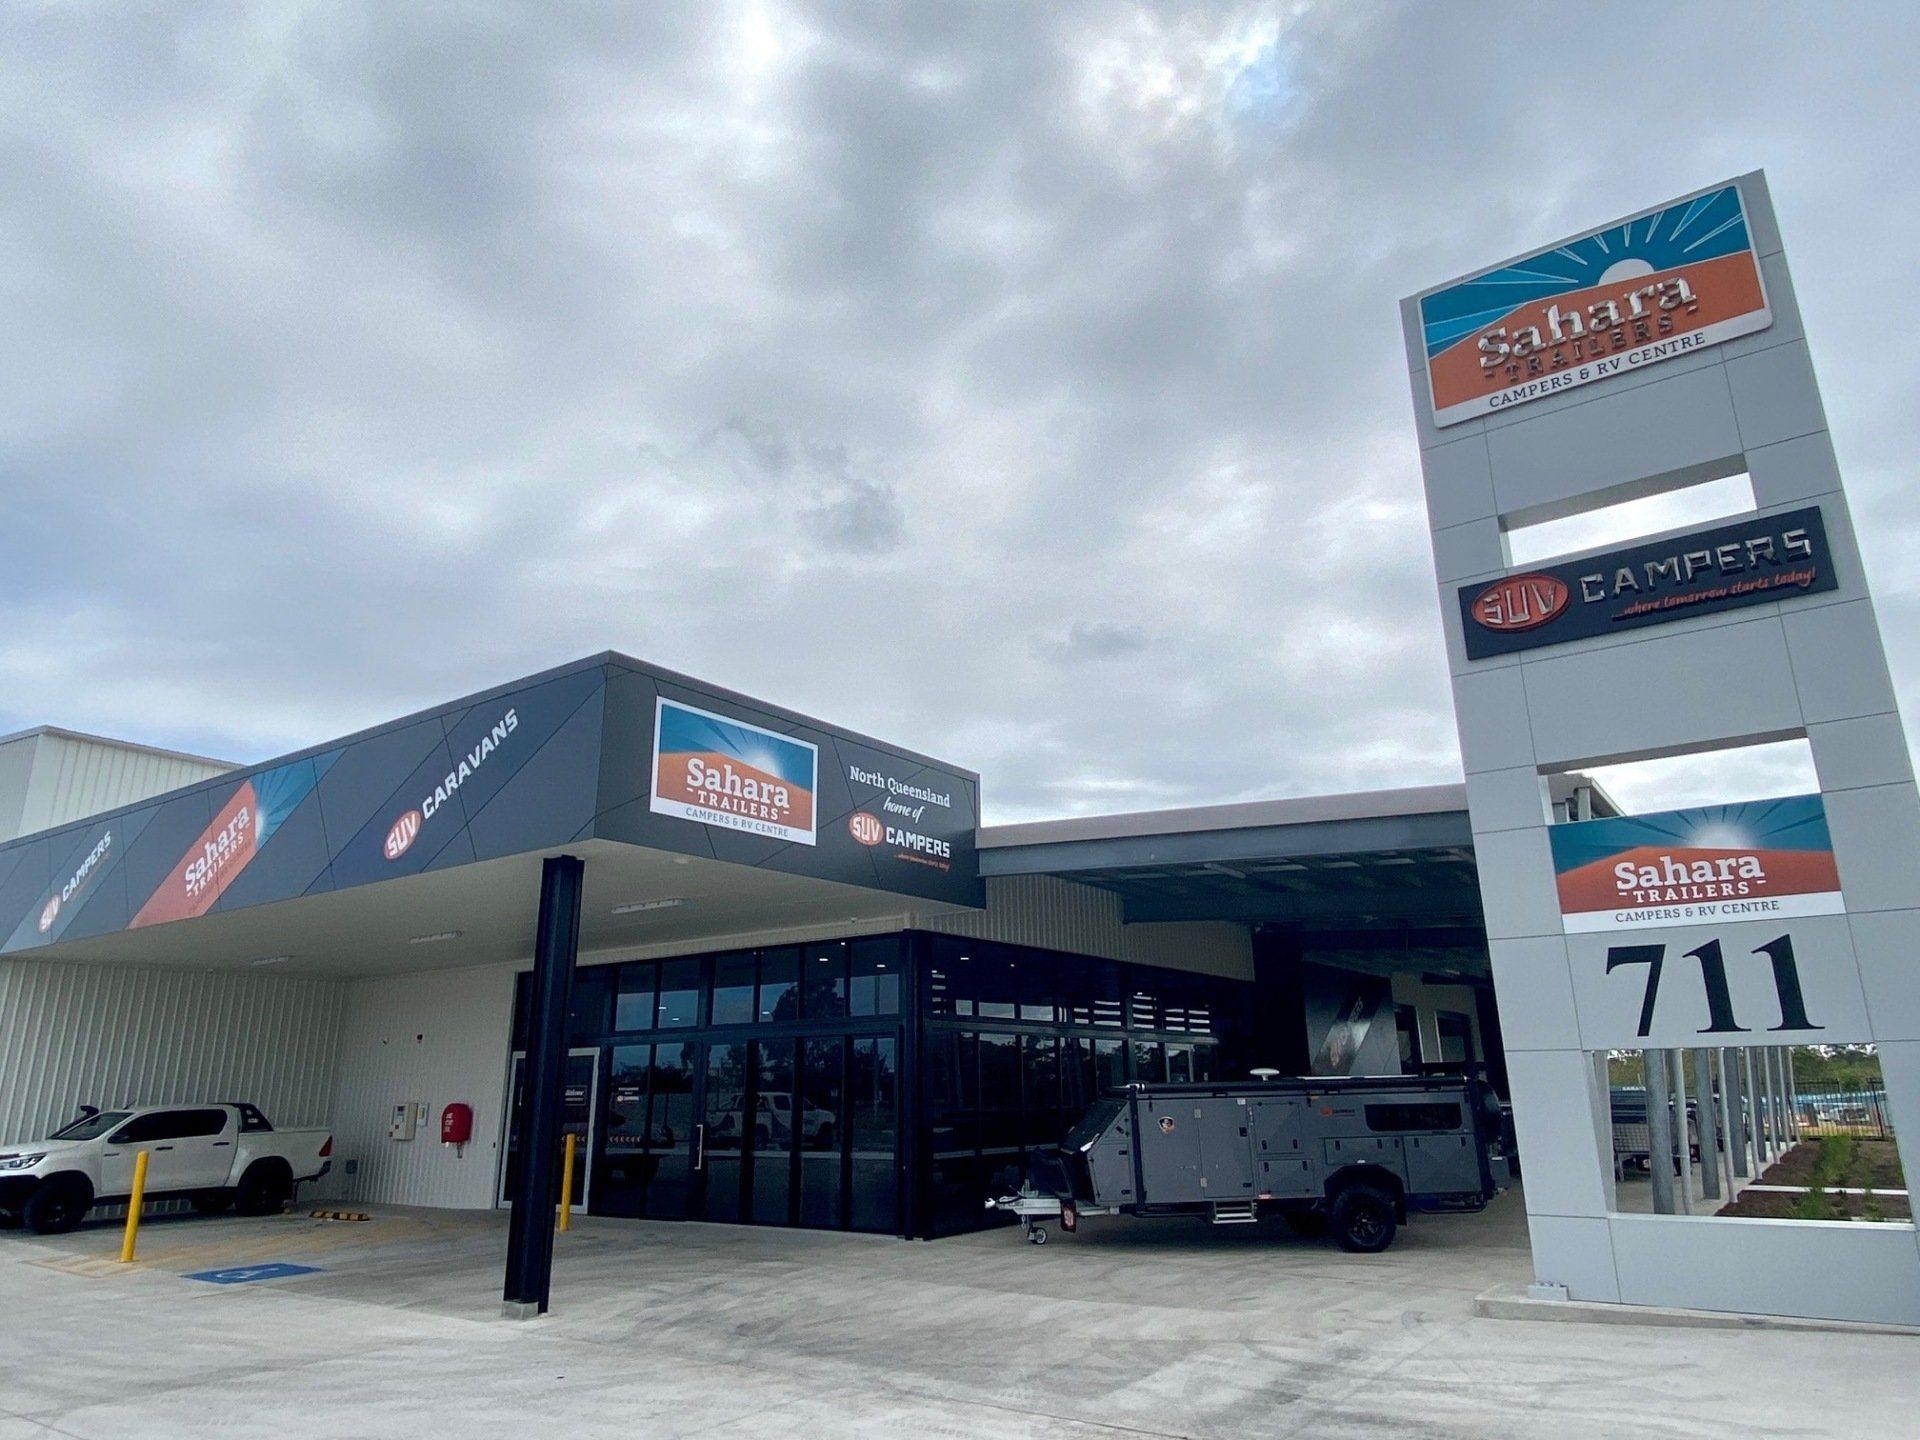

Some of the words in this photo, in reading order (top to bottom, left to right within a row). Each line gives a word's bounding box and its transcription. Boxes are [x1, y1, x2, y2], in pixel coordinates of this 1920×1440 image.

[1477, 277, 1699, 369] Sahara
[1504, 313, 1674, 382] TRAILERS
[1489, 371, 1573, 408] CAMPERS
[1579, 368, 1590, 381] &
[1597, 358, 1621, 376] RV
[1629, 331, 1706, 367] CENTRE
[1484, 582, 1557, 625] SUV
[1579, 528, 1813, 604] CAMPERS
[1663, 588, 1728, 607] tomorrow
[1730, 576, 1770, 595] starts
[1774, 567, 1817, 588] today!
[385, 813, 417, 857] SUV
[422, 708, 519, 820] CARAVANS
[686, 758, 790, 808] Sahara
[698, 789, 779, 821] TRAILERS
[849, 766, 886, 789] North
[887, 777, 951, 808] Queensland
[686, 807, 730, 825] CAMPERS
[732, 818, 738, 826] &
[741, 819, 753, 829] RV
[755, 822, 789, 837] CENTRE
[883, 796, 911, 817] home
[912, 805, 926, 824] of
[185, 806, 250, 892] Sahara
[852, 815, 881, 841] SUV
[885, 826, 951, 859] CAMPERS
[62, 830, 111, 902] CAMPERS
[194, 831, 245, 897] TRAILERS
[1613, 855, 1766, 891] Sahara
[1615, 907, 1681, 923] CAMPERS
[1685, 906, 1693, 917] &
[1698, 905, 1717, 917] RV
[1722, 900, 1780, 915] CENTRE
[1632, 881, 1750, 904] TRAILERS
[1605, 933, 1826, 1037] 711
